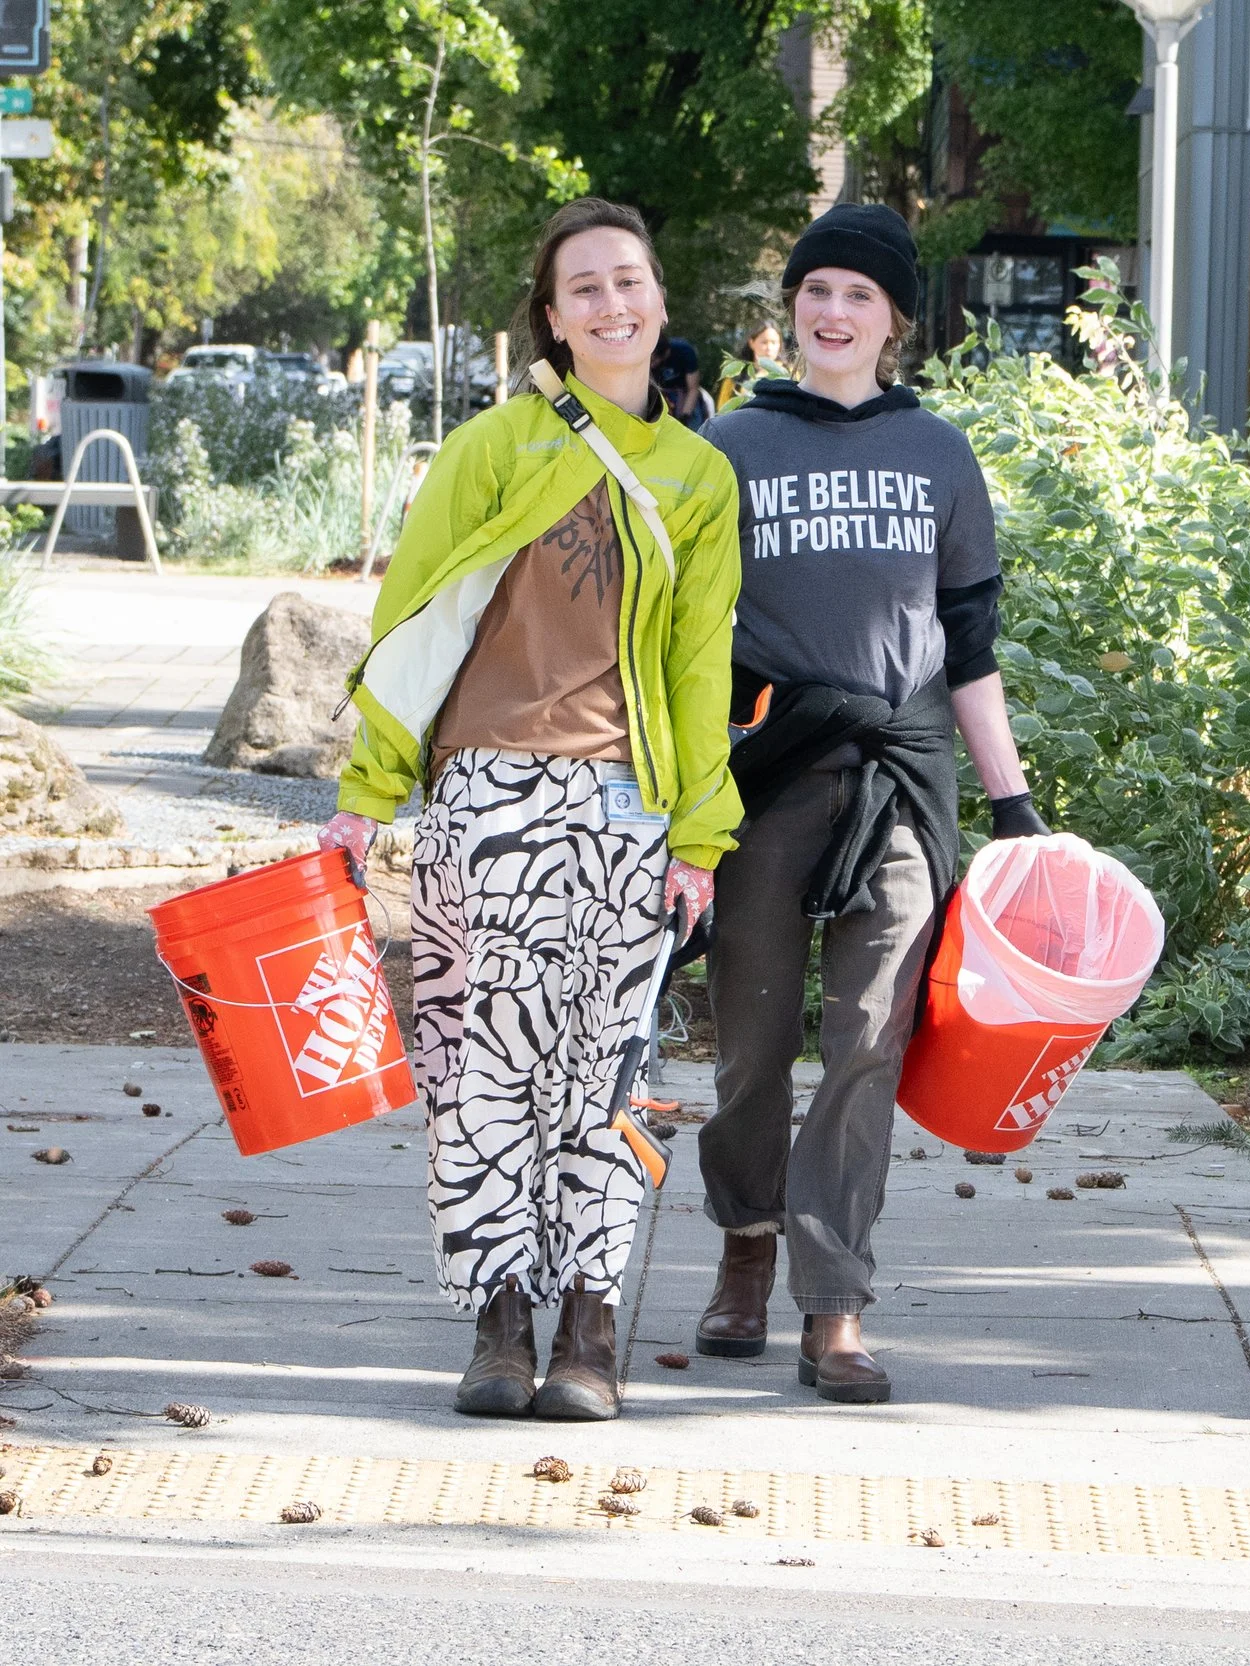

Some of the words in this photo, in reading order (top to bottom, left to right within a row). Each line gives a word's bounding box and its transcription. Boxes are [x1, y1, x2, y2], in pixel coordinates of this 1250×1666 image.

[749, 475, 800, 519] WE
[808, 470, 935, 513] BELIEVE
[753, 521, 781, 559] IN
[790, 515, 937, 554] PORTLAND
[290, 951, 341, 1017] THE
[1007, 1066, 1083, 1129] HO
